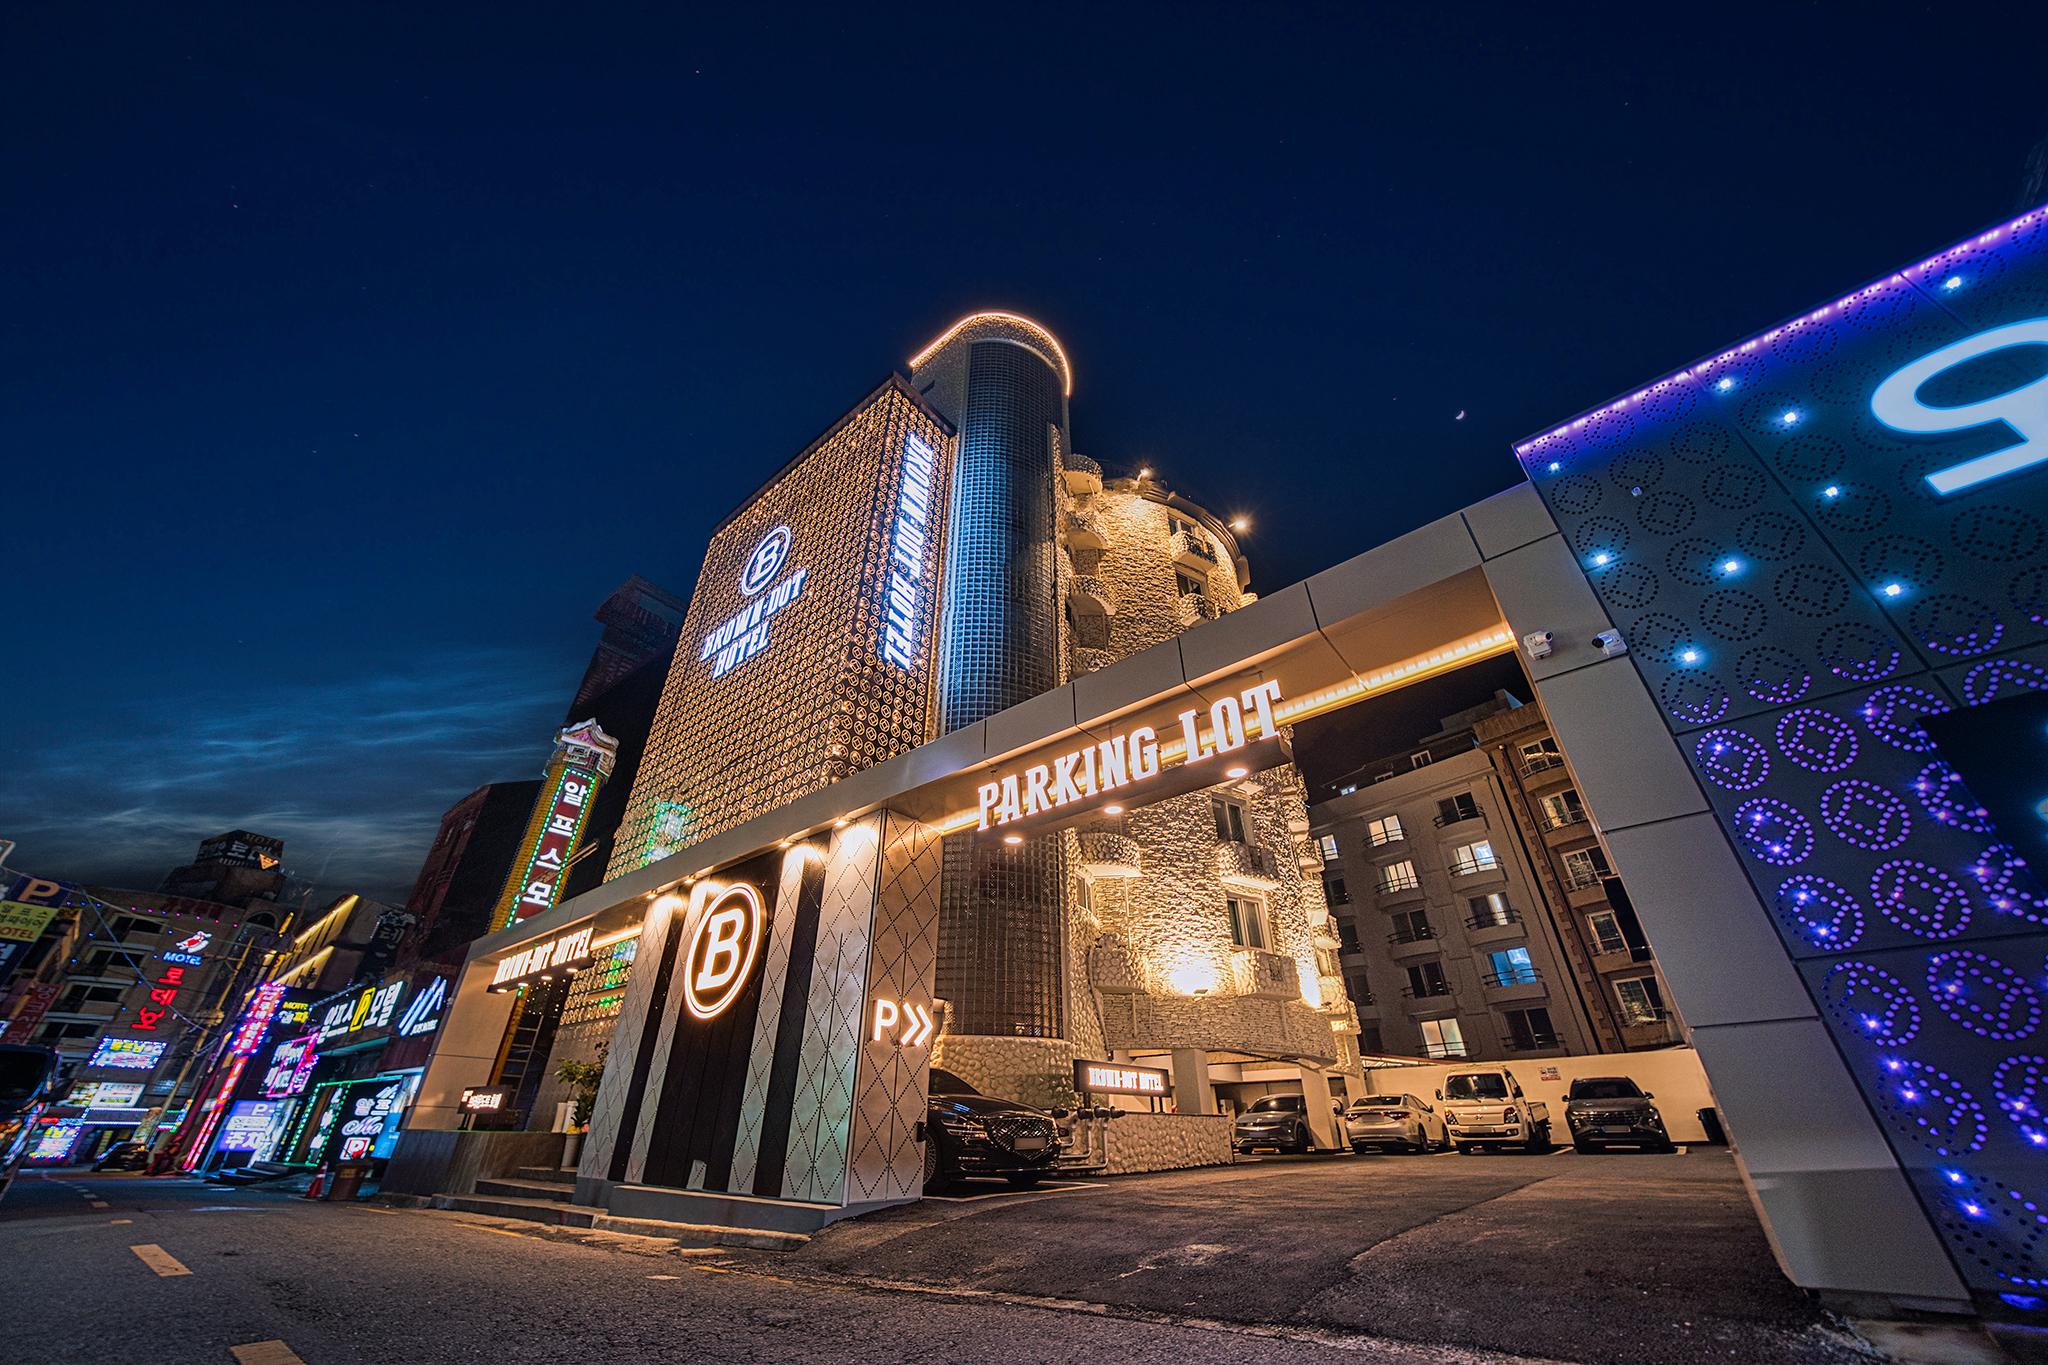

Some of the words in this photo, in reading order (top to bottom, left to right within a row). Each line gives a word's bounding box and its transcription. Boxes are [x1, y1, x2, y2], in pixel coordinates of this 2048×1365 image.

[712, 620, 771, 680] HOTEL
[881, 571, 918, 671] HOTEL
[977, 727, 1161, 832] PARKING
[1178, 680, 1284, 766] LOT
[18, 879, 60, 903] P
[873, 999, 899, 1041] P
